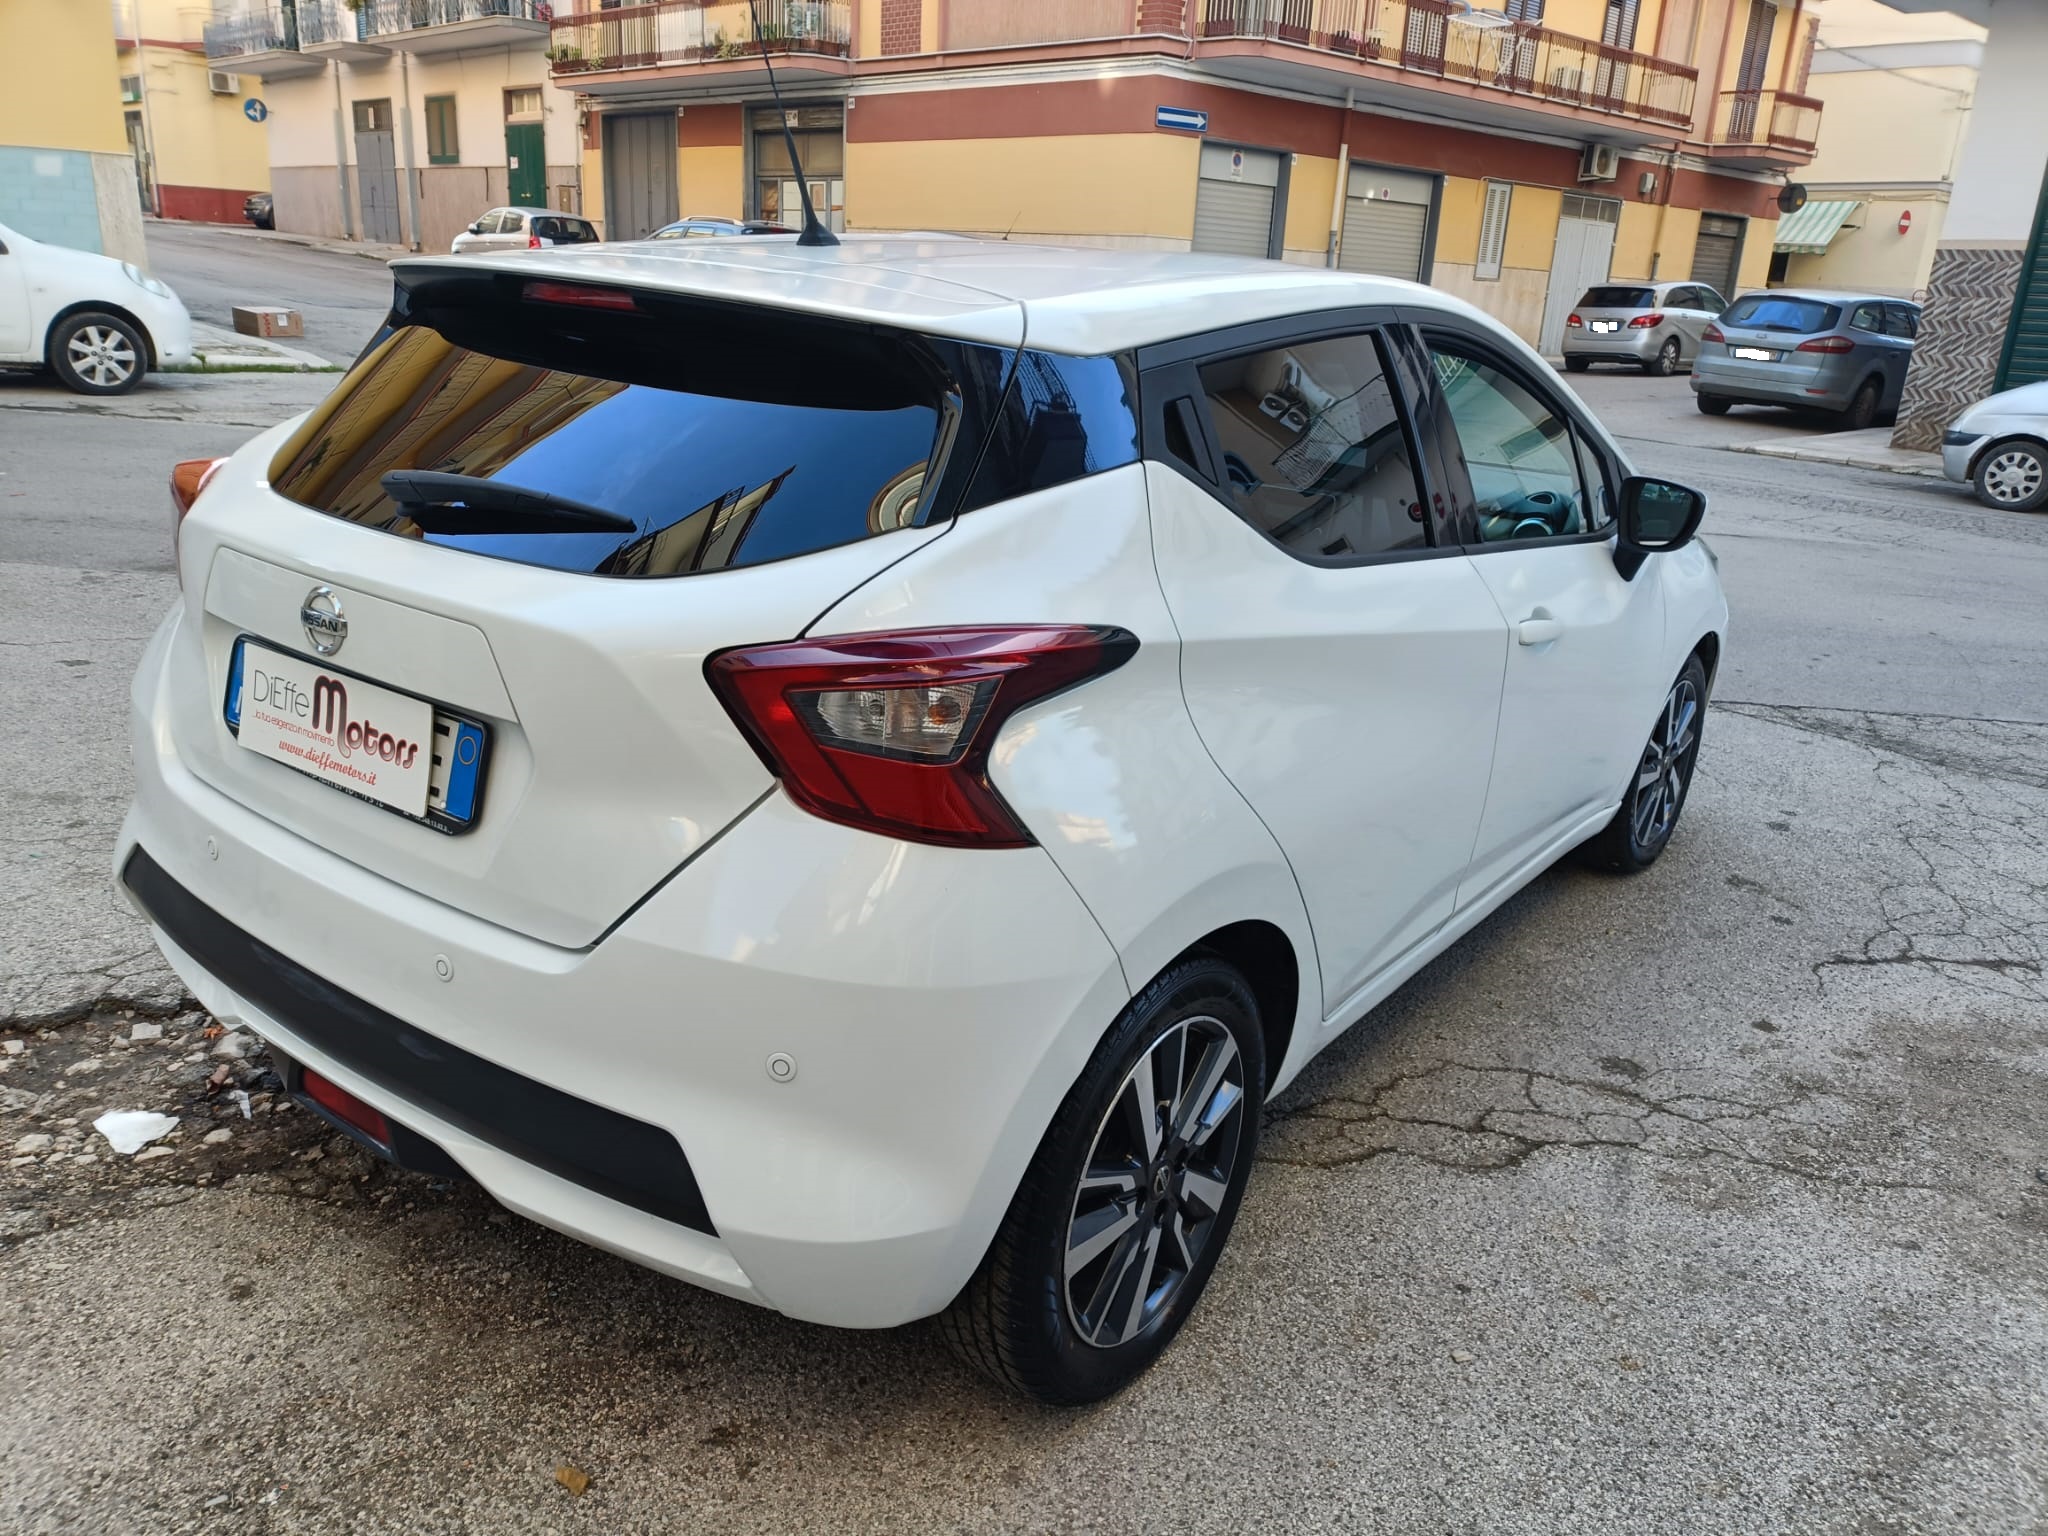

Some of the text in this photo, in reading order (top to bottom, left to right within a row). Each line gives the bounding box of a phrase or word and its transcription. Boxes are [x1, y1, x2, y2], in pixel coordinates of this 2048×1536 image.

[302, 609, 338, 632] NISSAN
[253, 669, 418, 769] DiEffe Motors
[279, 740, 377, 786] www.dieffemotors.it
